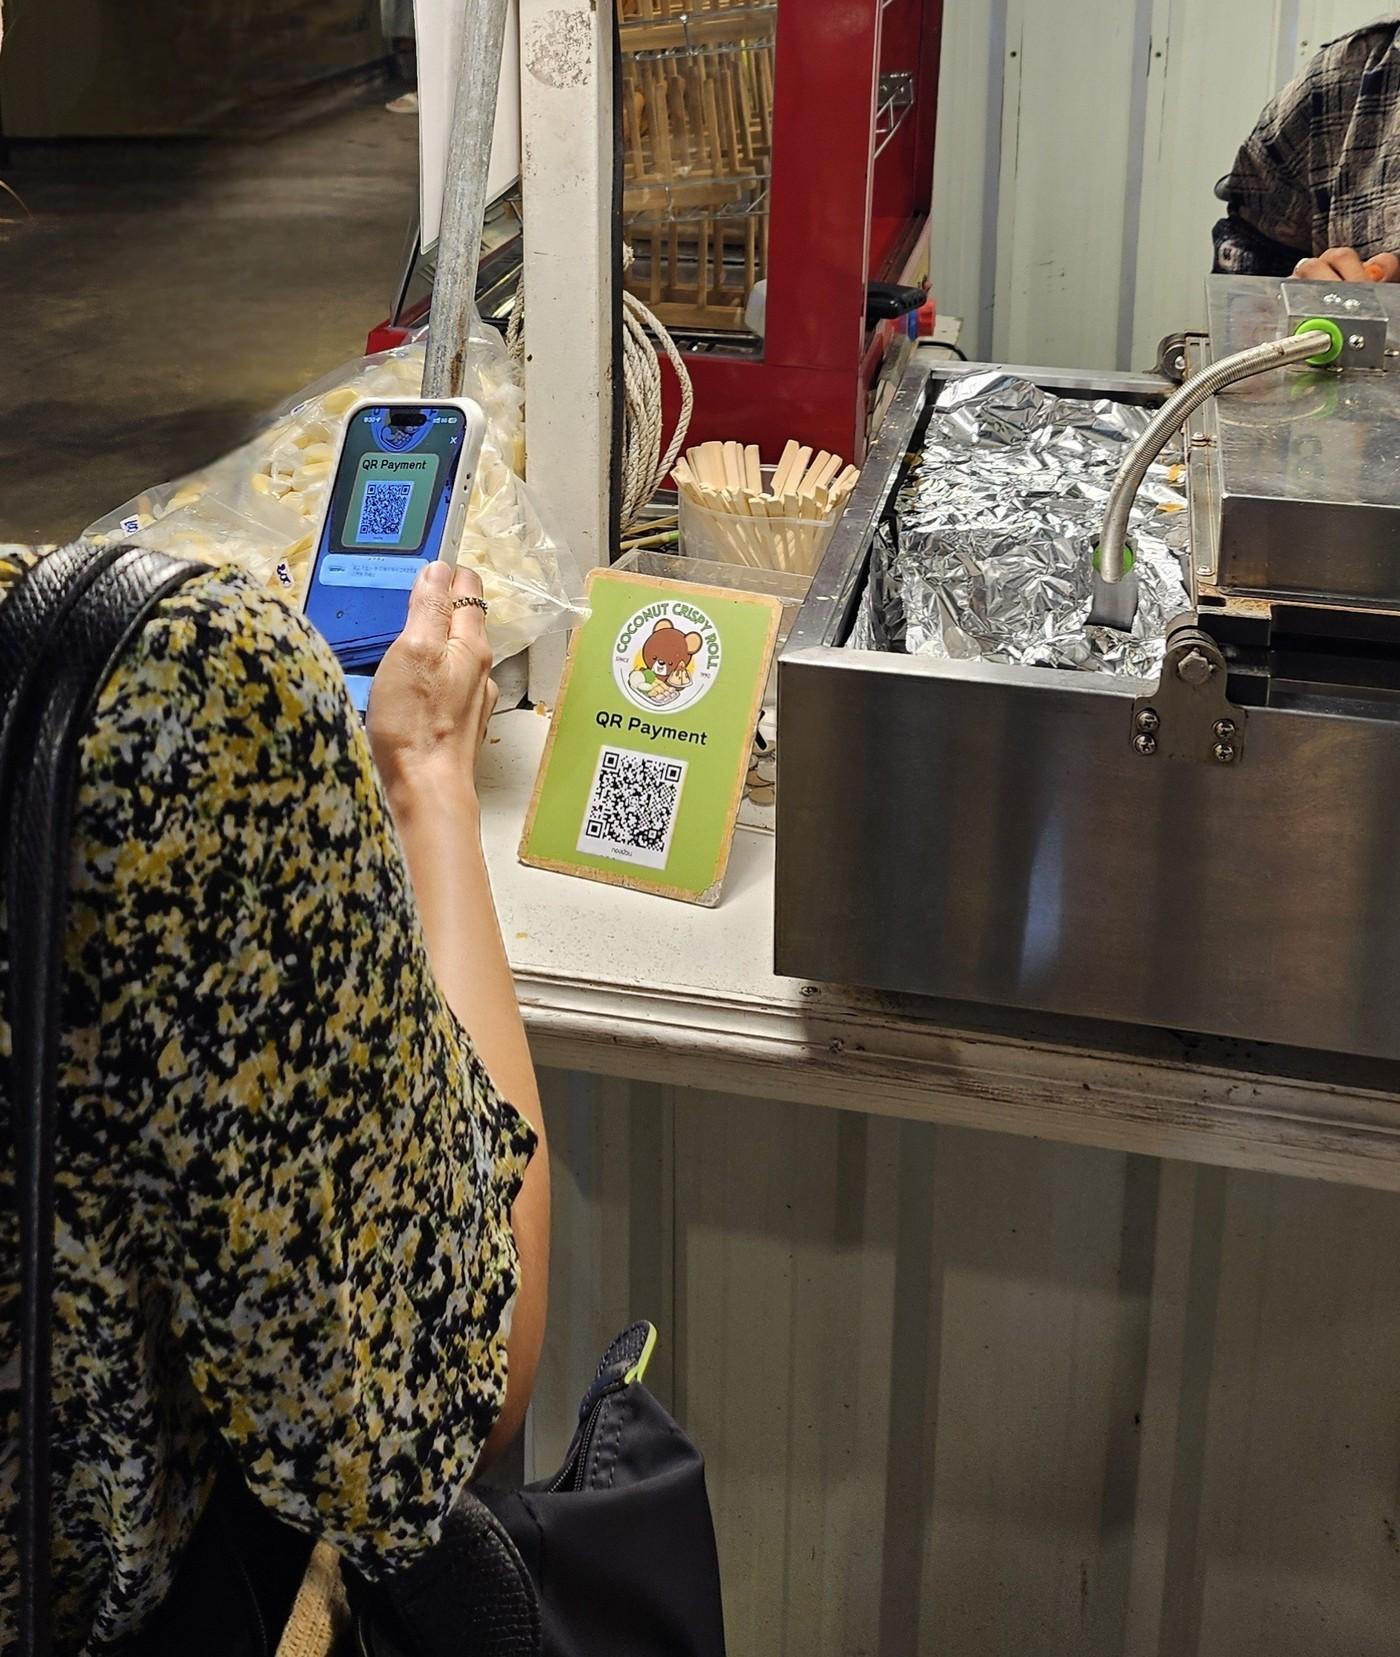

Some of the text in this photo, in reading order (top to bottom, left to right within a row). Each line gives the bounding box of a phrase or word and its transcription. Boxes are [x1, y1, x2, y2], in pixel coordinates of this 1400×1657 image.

[362, 459, 427, 472] QR Payment
[616, 603, 720, 670] COCONUT CRISPY ROLL
[595, 711, 708, 746] QR Payment
